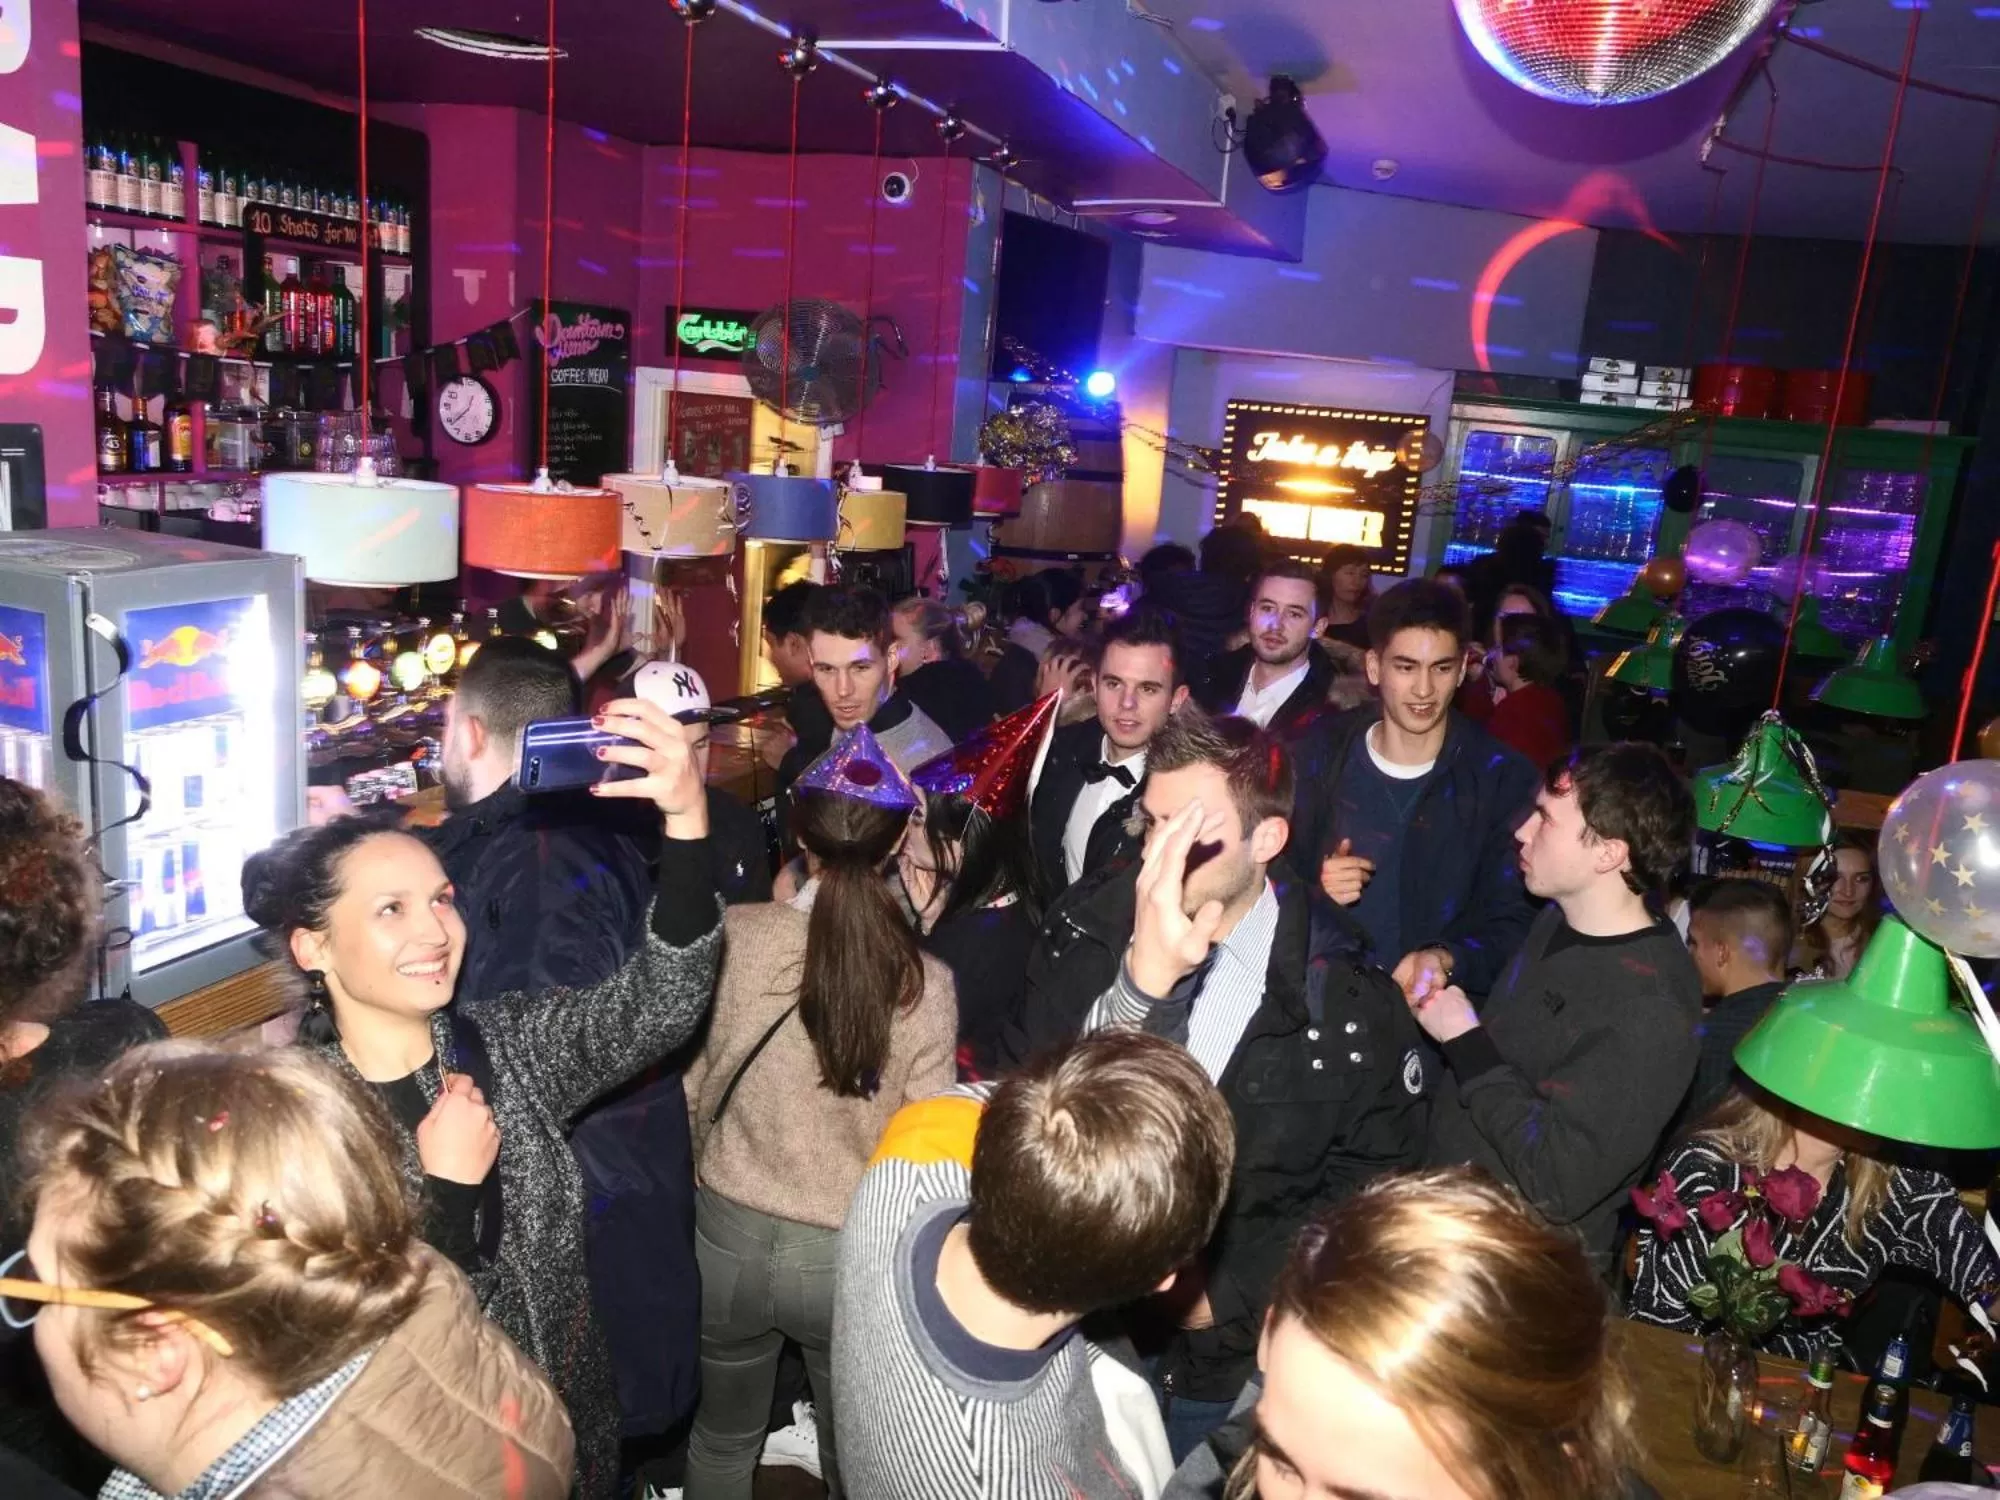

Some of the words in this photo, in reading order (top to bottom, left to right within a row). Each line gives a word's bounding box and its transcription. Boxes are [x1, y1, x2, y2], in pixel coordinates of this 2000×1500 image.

[252, 209, 272, 234] 10
[280, 213, 318, 239] Shots
[325, 222, 343, 245] for
[551, 368, 585, 383] COFFEE
[587, 368, 609, 385] MENU
[1247, 431, 1317, 465] Take
[1315, 444, 1341, 467] a
[1340, 440, 1398, 478] trip
